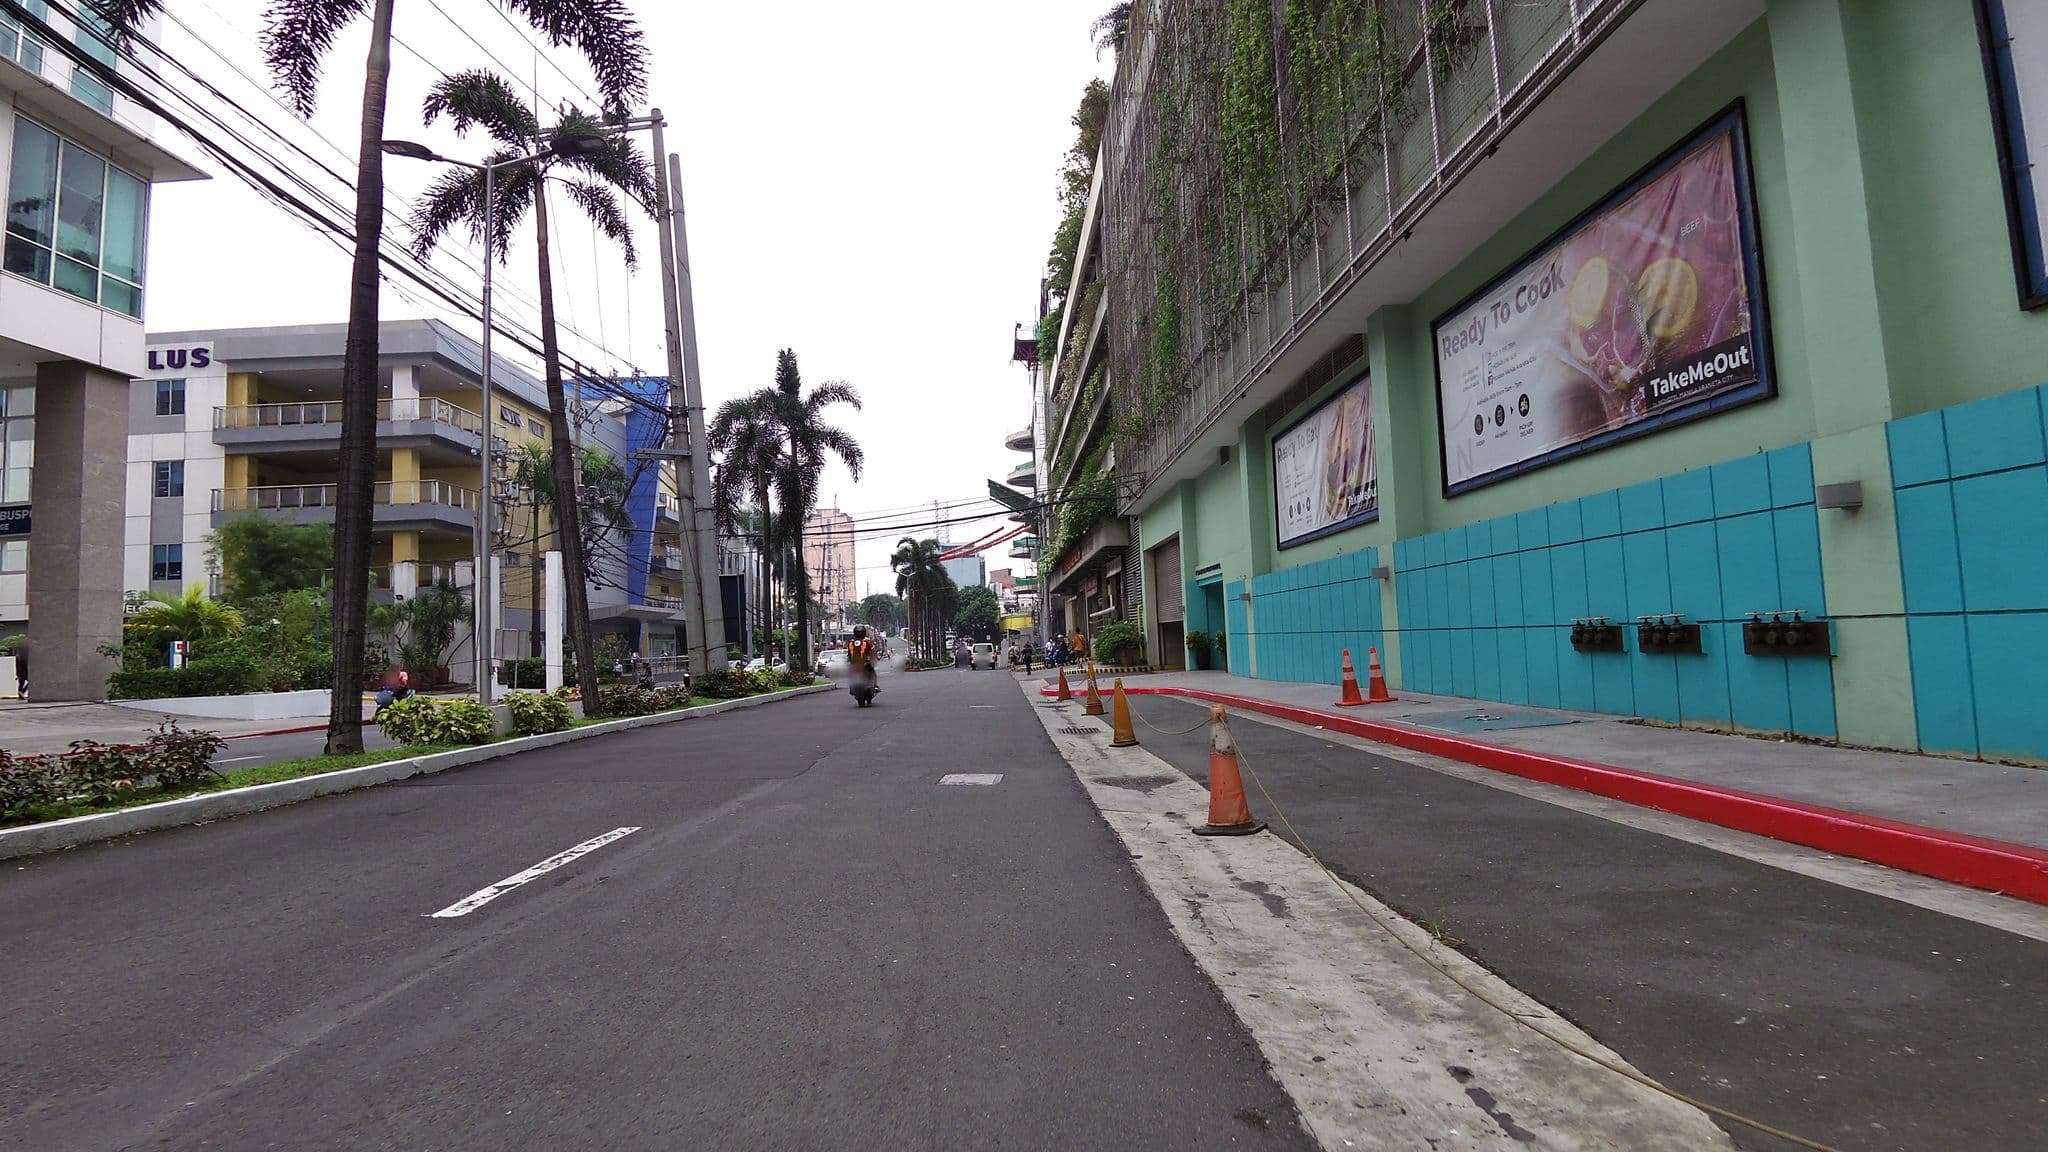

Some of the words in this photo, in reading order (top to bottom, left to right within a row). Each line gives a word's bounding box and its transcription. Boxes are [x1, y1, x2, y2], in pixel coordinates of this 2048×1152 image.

[1442, 316, 1487, 360] Ready
[1490, 301, 1511, 329] To
[1515, 262, 1566, 314] Cook
[148, 347, 210, 370] LUS
[1649, 345, 1750, 398] TakeMeOut
[1721, 374, 1734, 385] CITY
